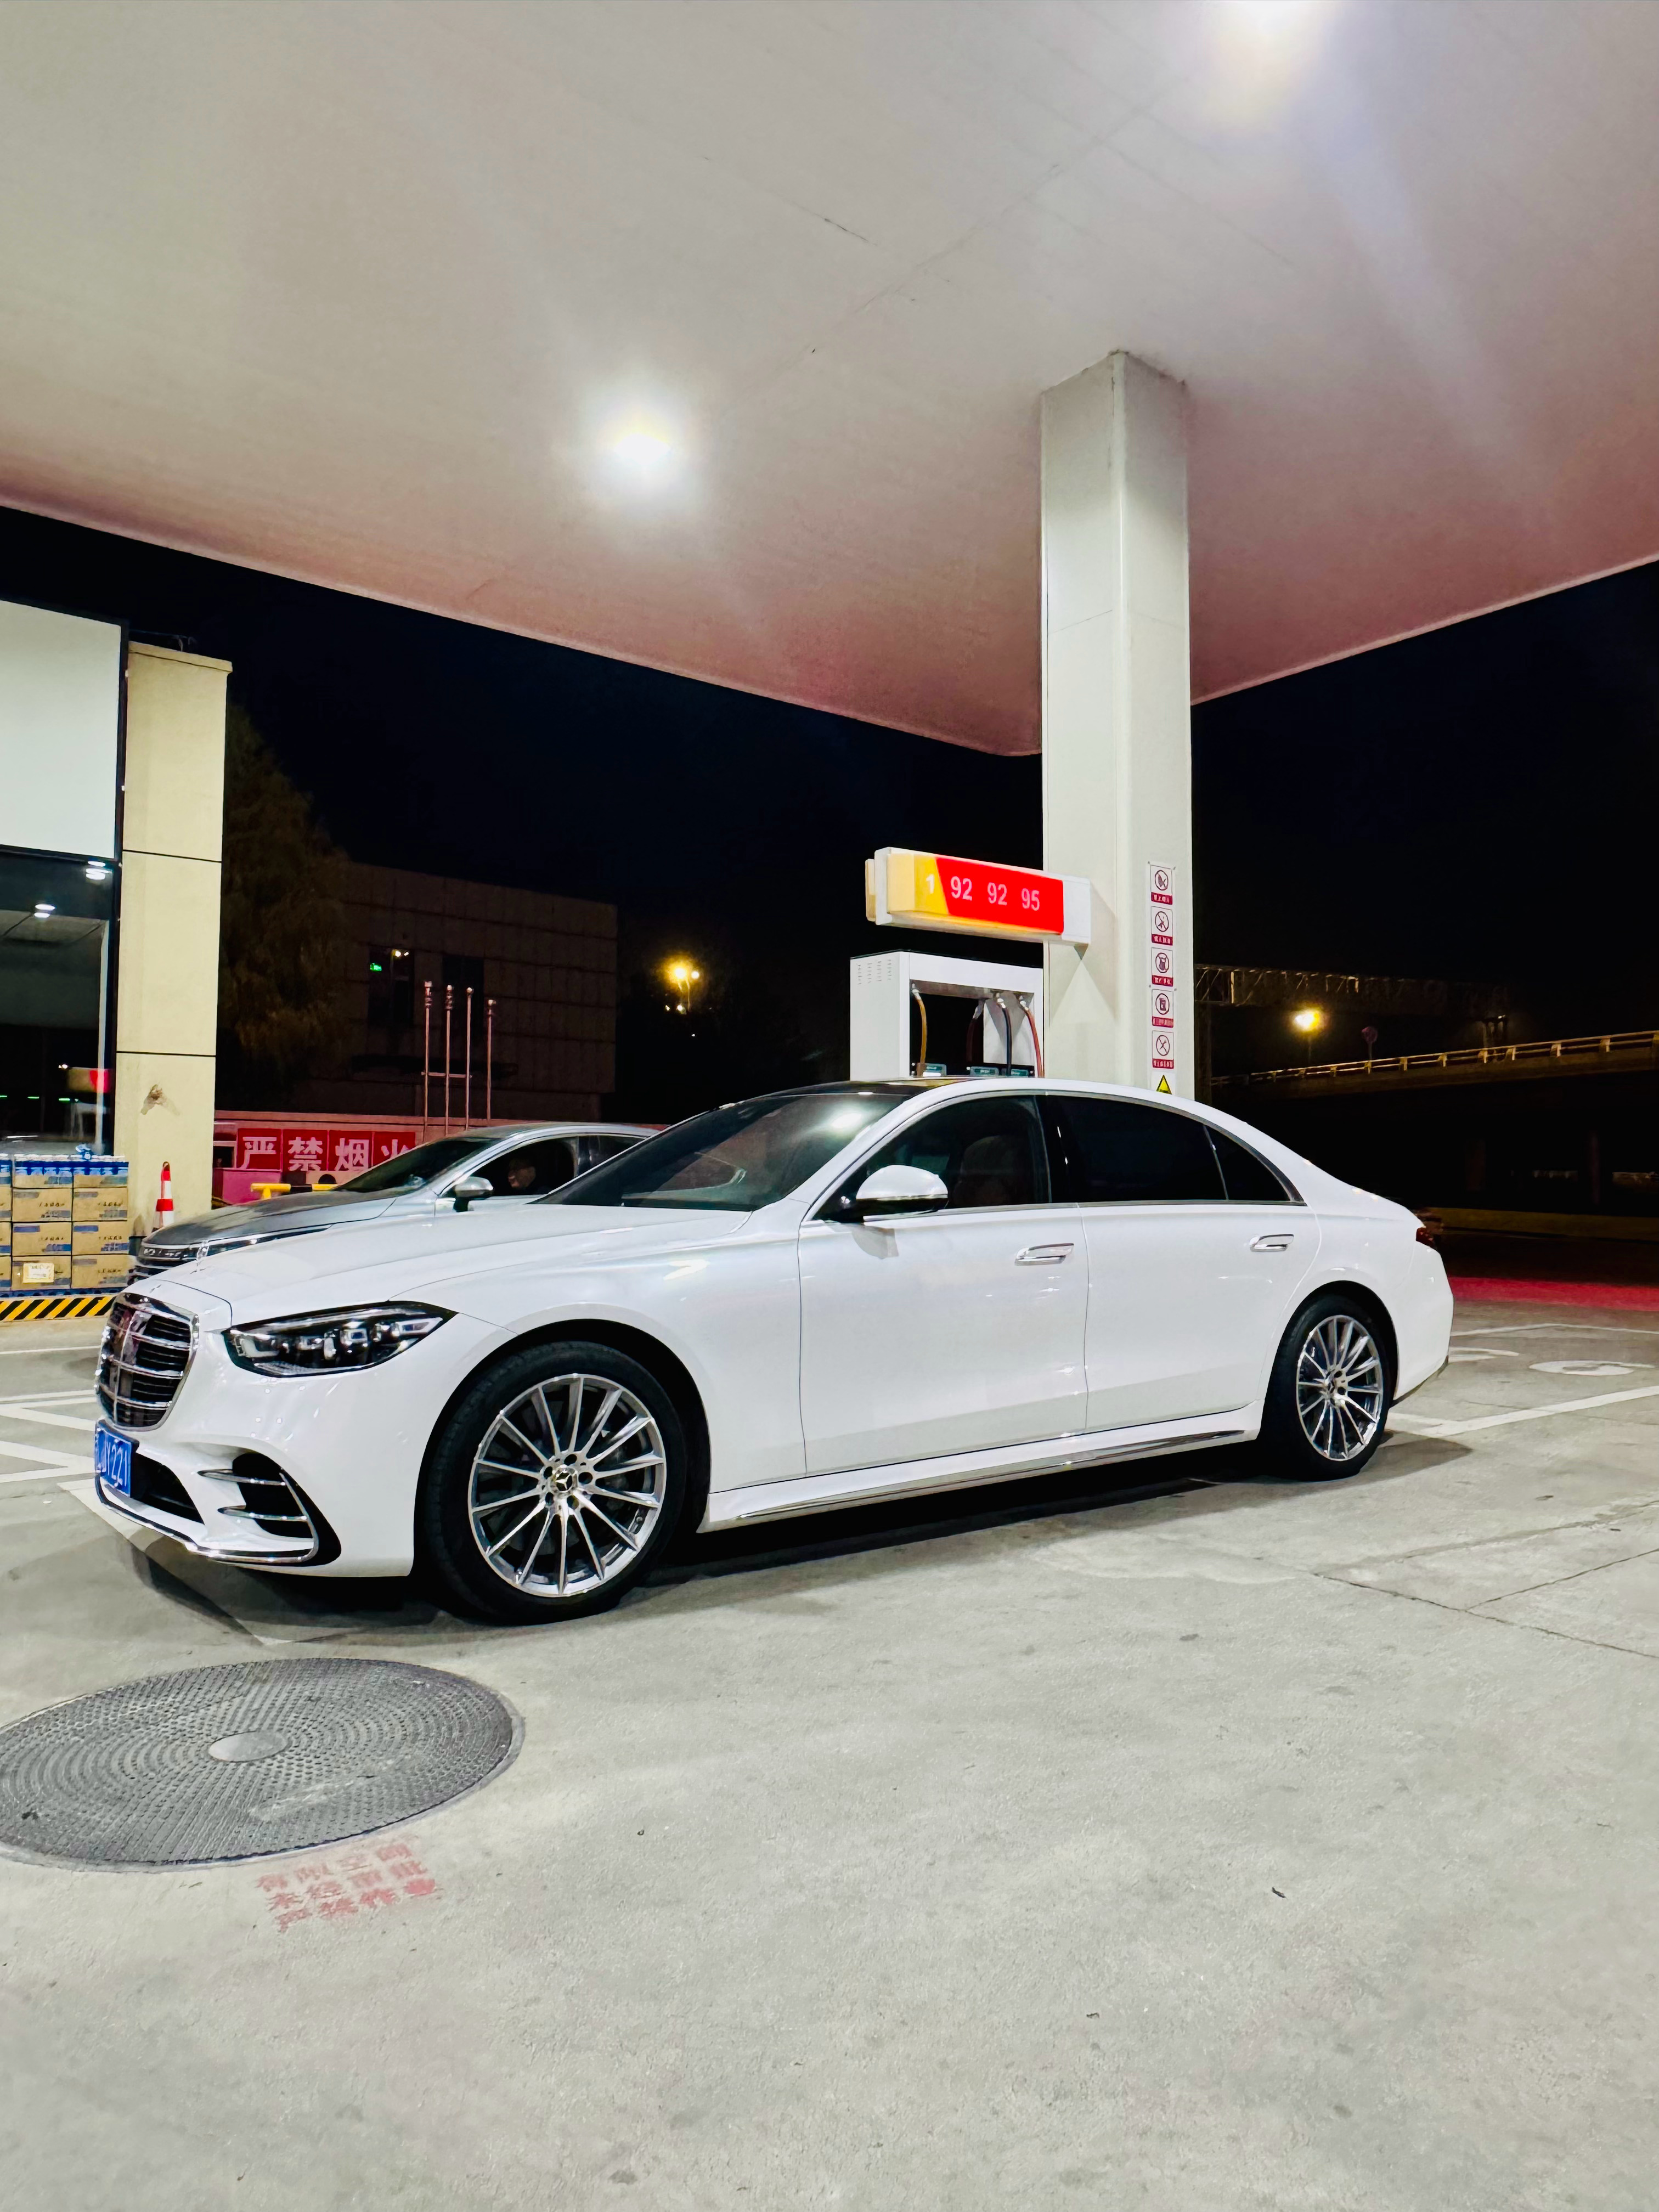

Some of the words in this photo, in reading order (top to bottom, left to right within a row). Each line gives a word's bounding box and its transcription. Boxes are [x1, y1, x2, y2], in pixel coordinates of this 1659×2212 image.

[926, 873, 934, 894] 1
[950, 876, 973, 901] 92
[988, 882, 1008, 906] 92
[1021, 887, 1040, 911] 95
